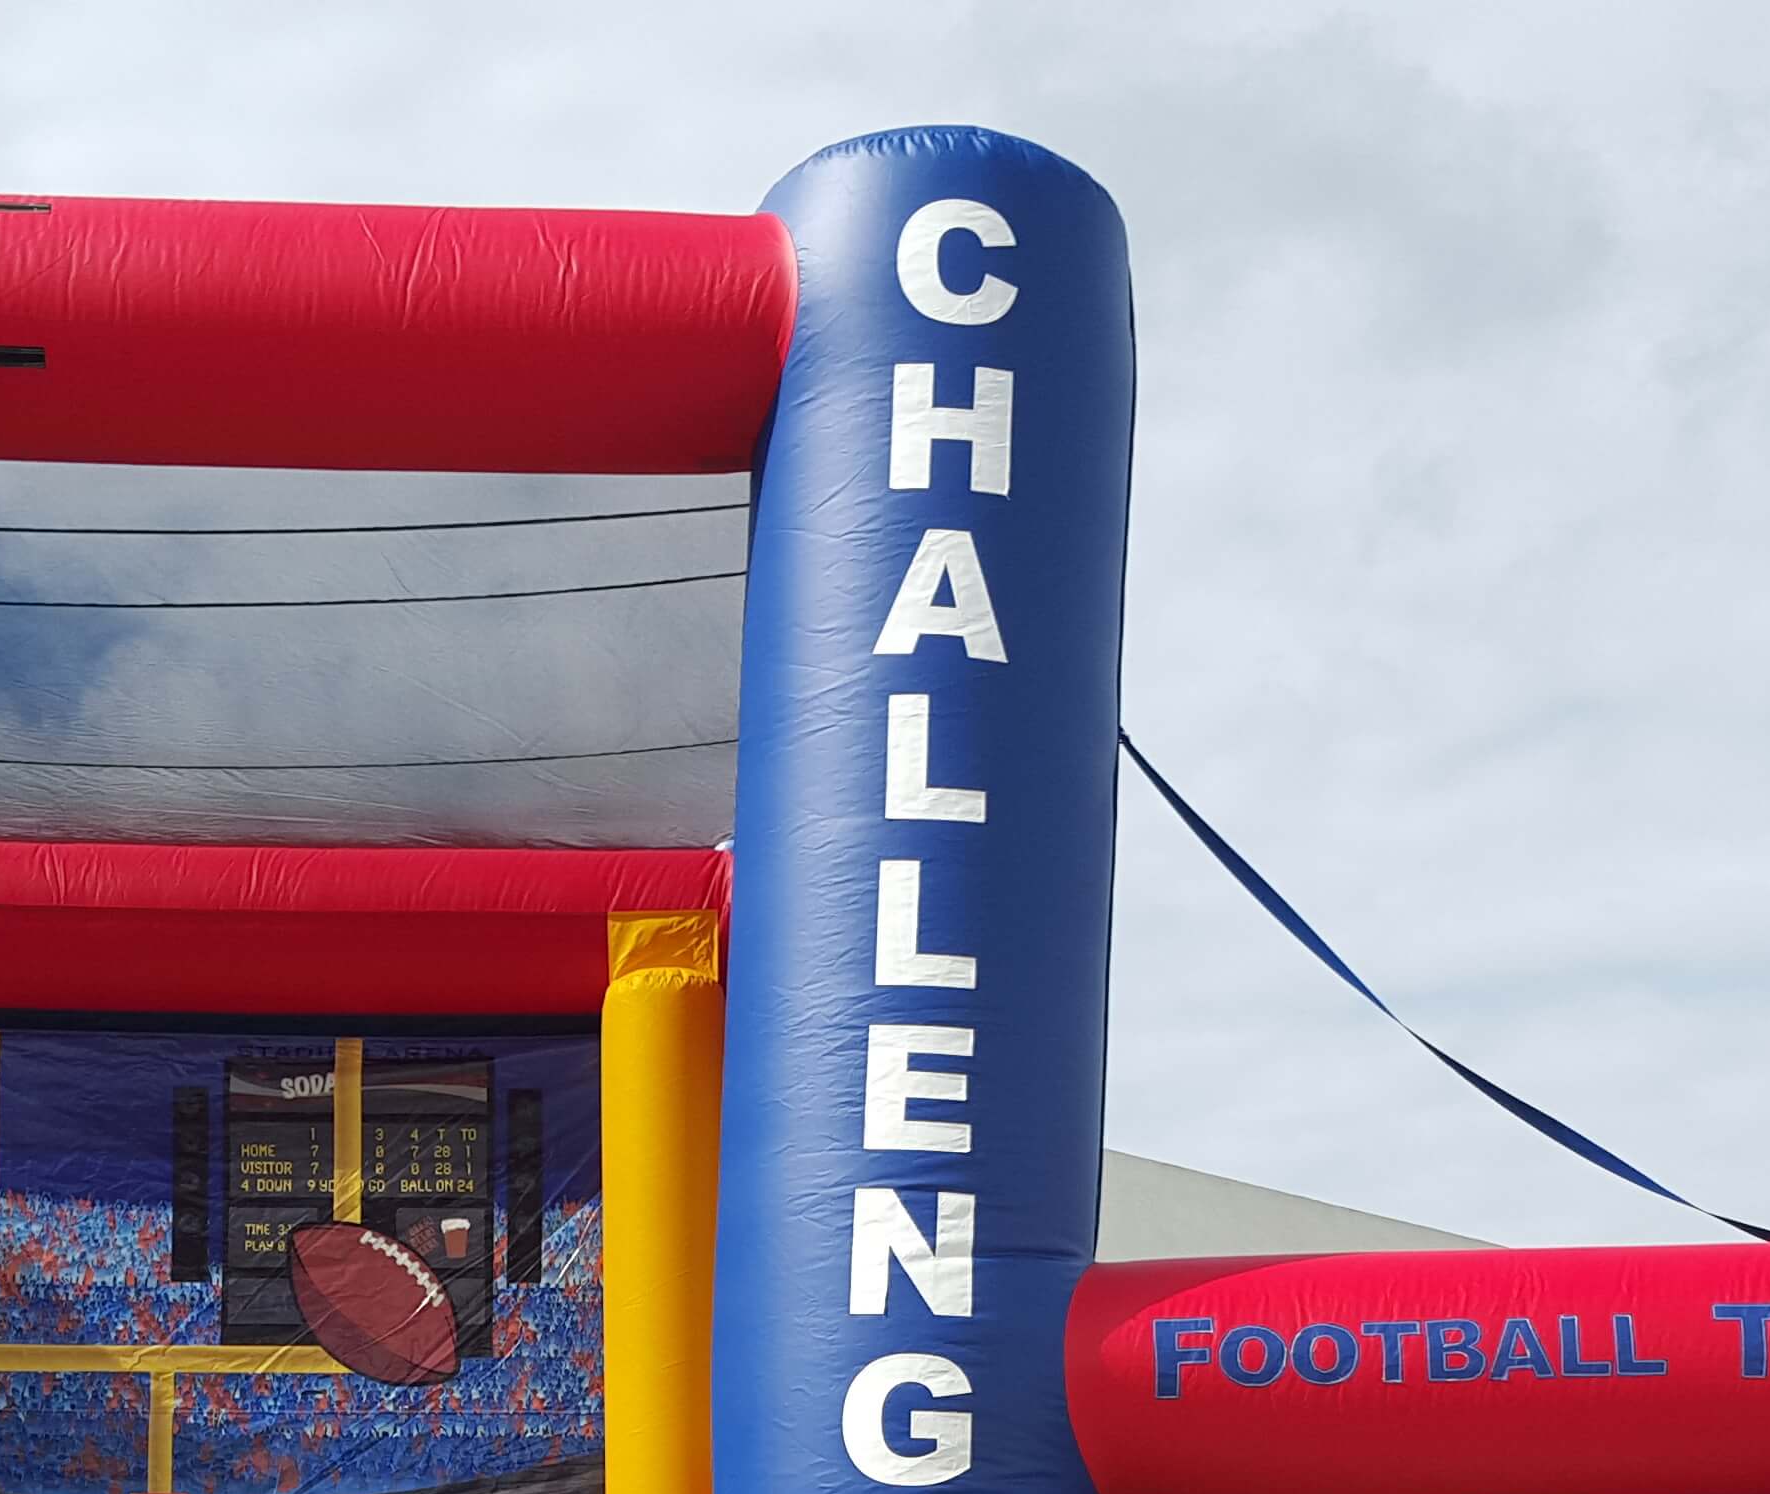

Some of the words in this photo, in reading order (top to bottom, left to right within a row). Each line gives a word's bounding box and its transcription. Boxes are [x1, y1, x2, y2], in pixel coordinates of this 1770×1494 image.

[280, 1071, 335, 1099] SODA
[375, 1128, 384, 1142] 3
[410, 1128, 419, 1142] 4
[240, 1144, 276, 1157] HOME
[311, 1145, 319, 1158] 7
[240, 1162, 293, 1175] VISITOR
[311, 1162, 319, 1175] 7
[434, 1161, 451, 1175] 28
[240, 1179, 249, 1192] 4
[256, 1179, 292, 1192] DOWN
[307, 1180, 316, 1193] 9
[400, 1179, 432, 1193] BALL
[436, 1179, 453, 1193] ON
[457, 1179, 474, 1193] 24
[244, 1223, 270, 1235] TIME
[244, 1239, 274, 1252] PLAY
[1151, 1311, 1668, 1400] FOOTBALL
